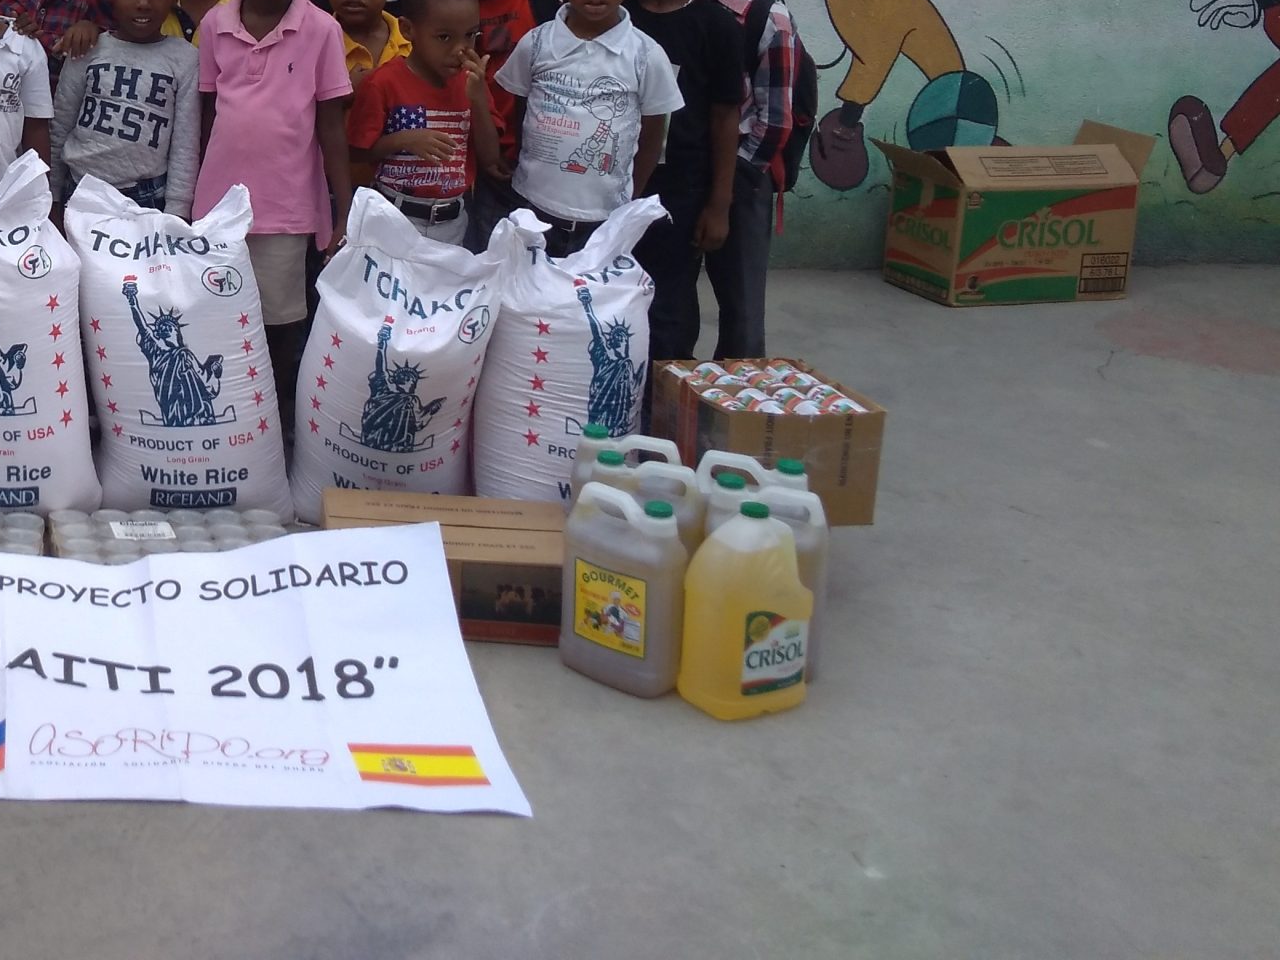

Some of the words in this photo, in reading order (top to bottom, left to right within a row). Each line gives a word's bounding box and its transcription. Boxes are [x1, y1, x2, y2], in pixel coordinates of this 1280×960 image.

[85, 62, 174, 108] THE
[78, 95, 170, 150] BEST
[89, 229, 210, 260] TCHAKO
[997, 216, 1102, 250] CRISOL
[405, 325, 436, 336] Brand
[2, 429, 21, 442] OF
[27, 424, 55, 443] USA
[129, 434, 194, 452] PRODUCT
[202, 437, 221, 451] OF
[228, 432, 254, 448] USA
[166, 455, 185, 466] Long
[186, 455, 210, 465] Grain
[324, 437, 388, 474] PRODUCT
[397, 460, 415, 476] OF
[419, 455, 445, 473] USA
[6, 463, 53, 482] Rice
[140, 464, 200, 486] White
[205, 465, 250, 485] Rice
[155, 491, 233, 506] RICELAND
[199, 559, 409, 602] SOLIDARIO
[582, 570, 640, 602] GOURMET
[745, 640, 804, 671] CRISOL
[207, 654, 400, 702] 2018"
